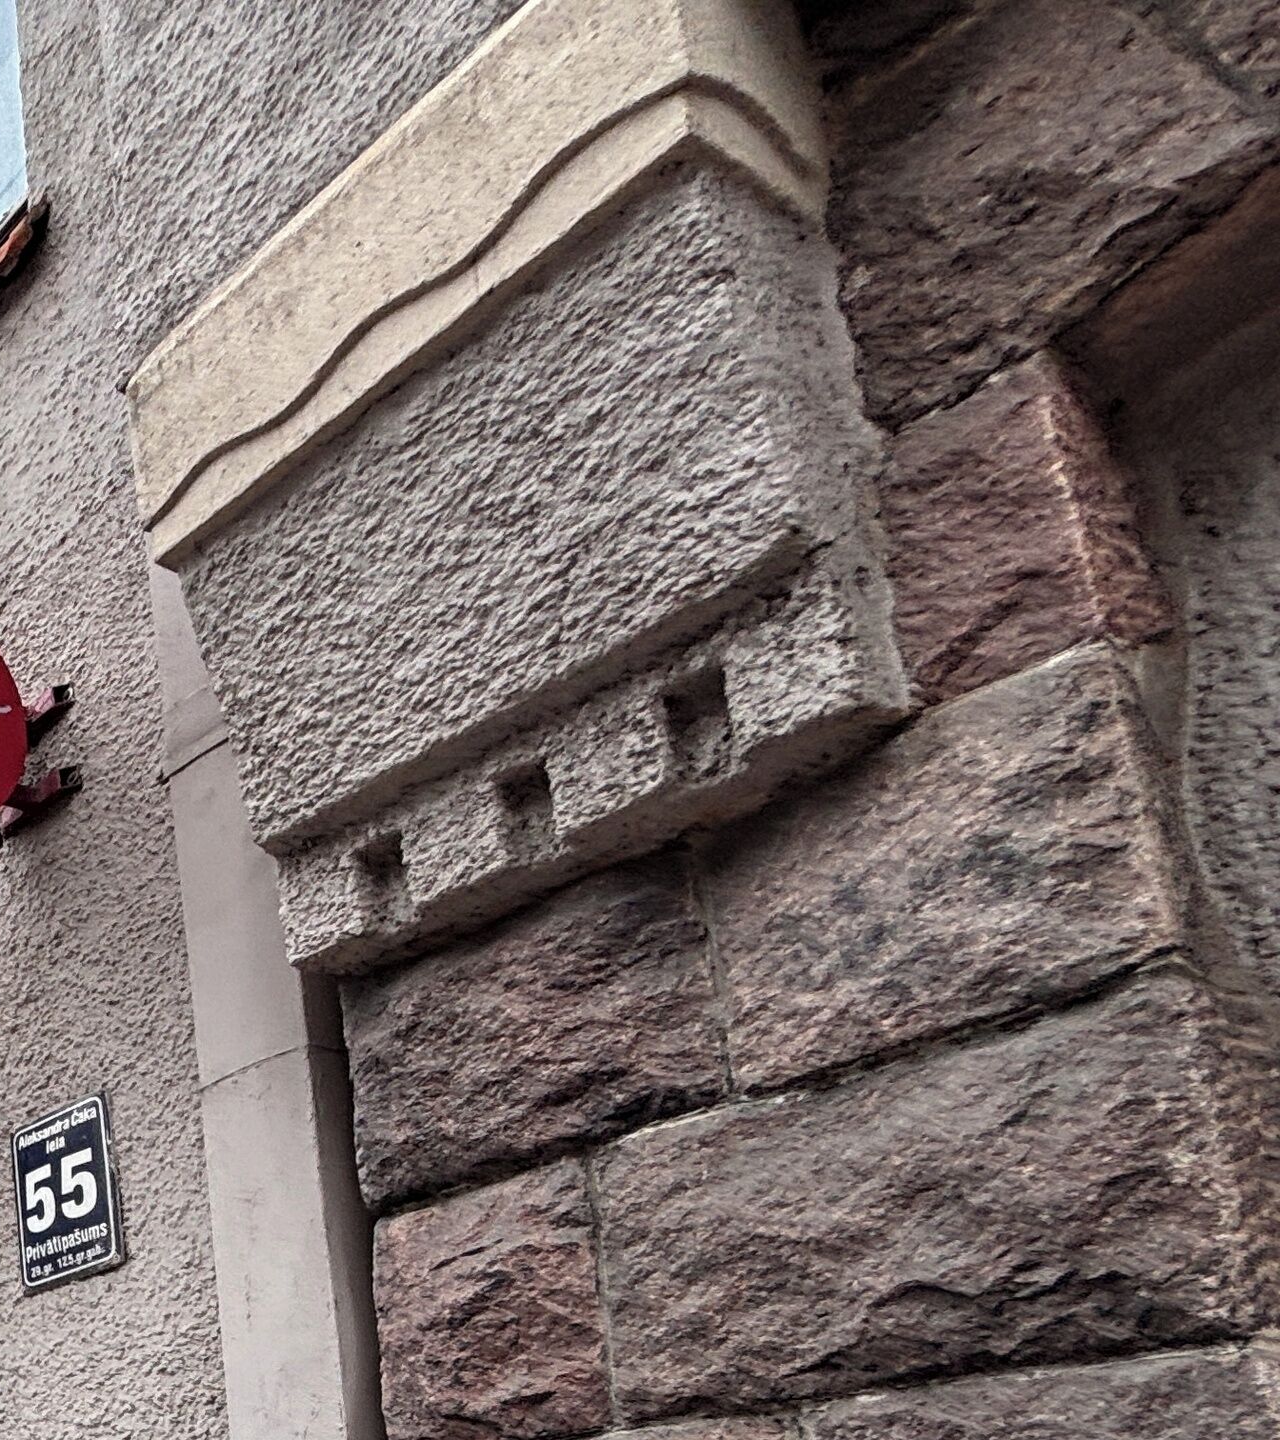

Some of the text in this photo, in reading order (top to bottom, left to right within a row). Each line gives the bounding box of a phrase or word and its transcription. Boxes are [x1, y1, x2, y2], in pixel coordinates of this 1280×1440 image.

[18, 1106, 97, 1151] Aleksandra Čaka
[25, 1147, 98, 1233] 55
[26, 1222, 108, 1264] Privātīpašums
